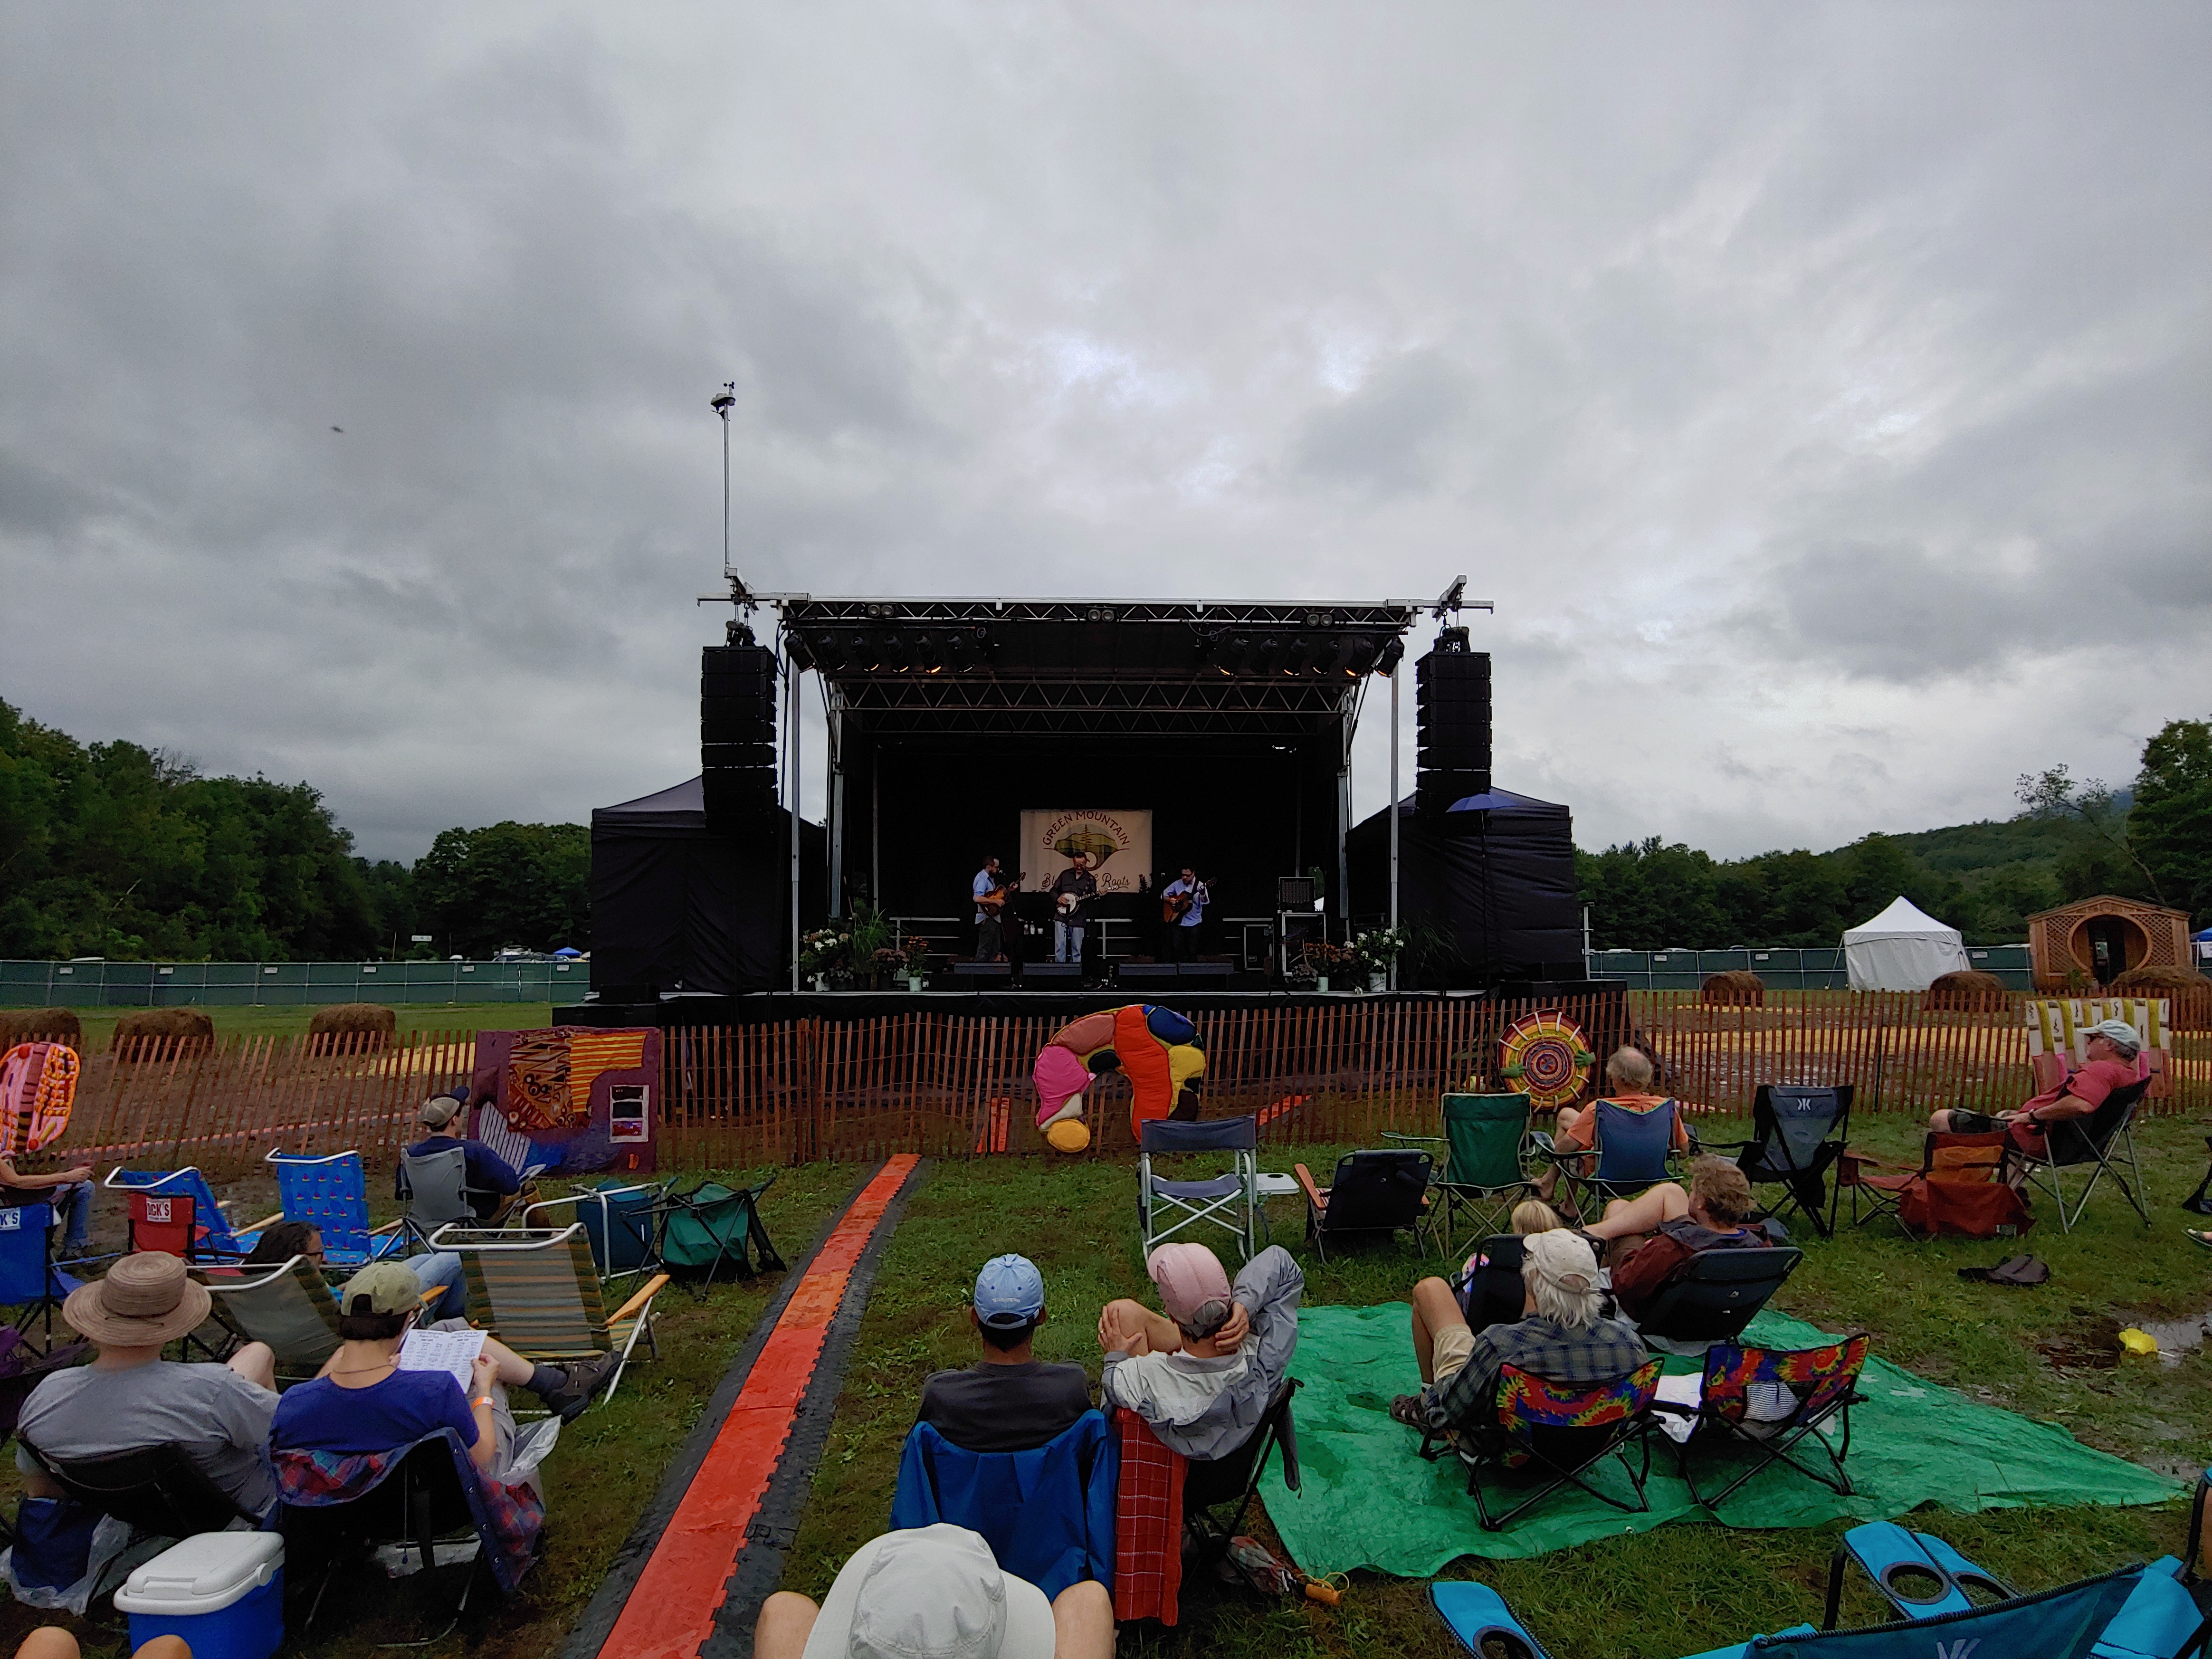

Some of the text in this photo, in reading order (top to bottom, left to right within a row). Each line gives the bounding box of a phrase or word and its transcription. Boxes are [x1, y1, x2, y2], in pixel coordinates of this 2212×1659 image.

[1043, 811, 1130, 845] GREEN MOUNTAIN
[1101, 873, 1130, 888] Roots
